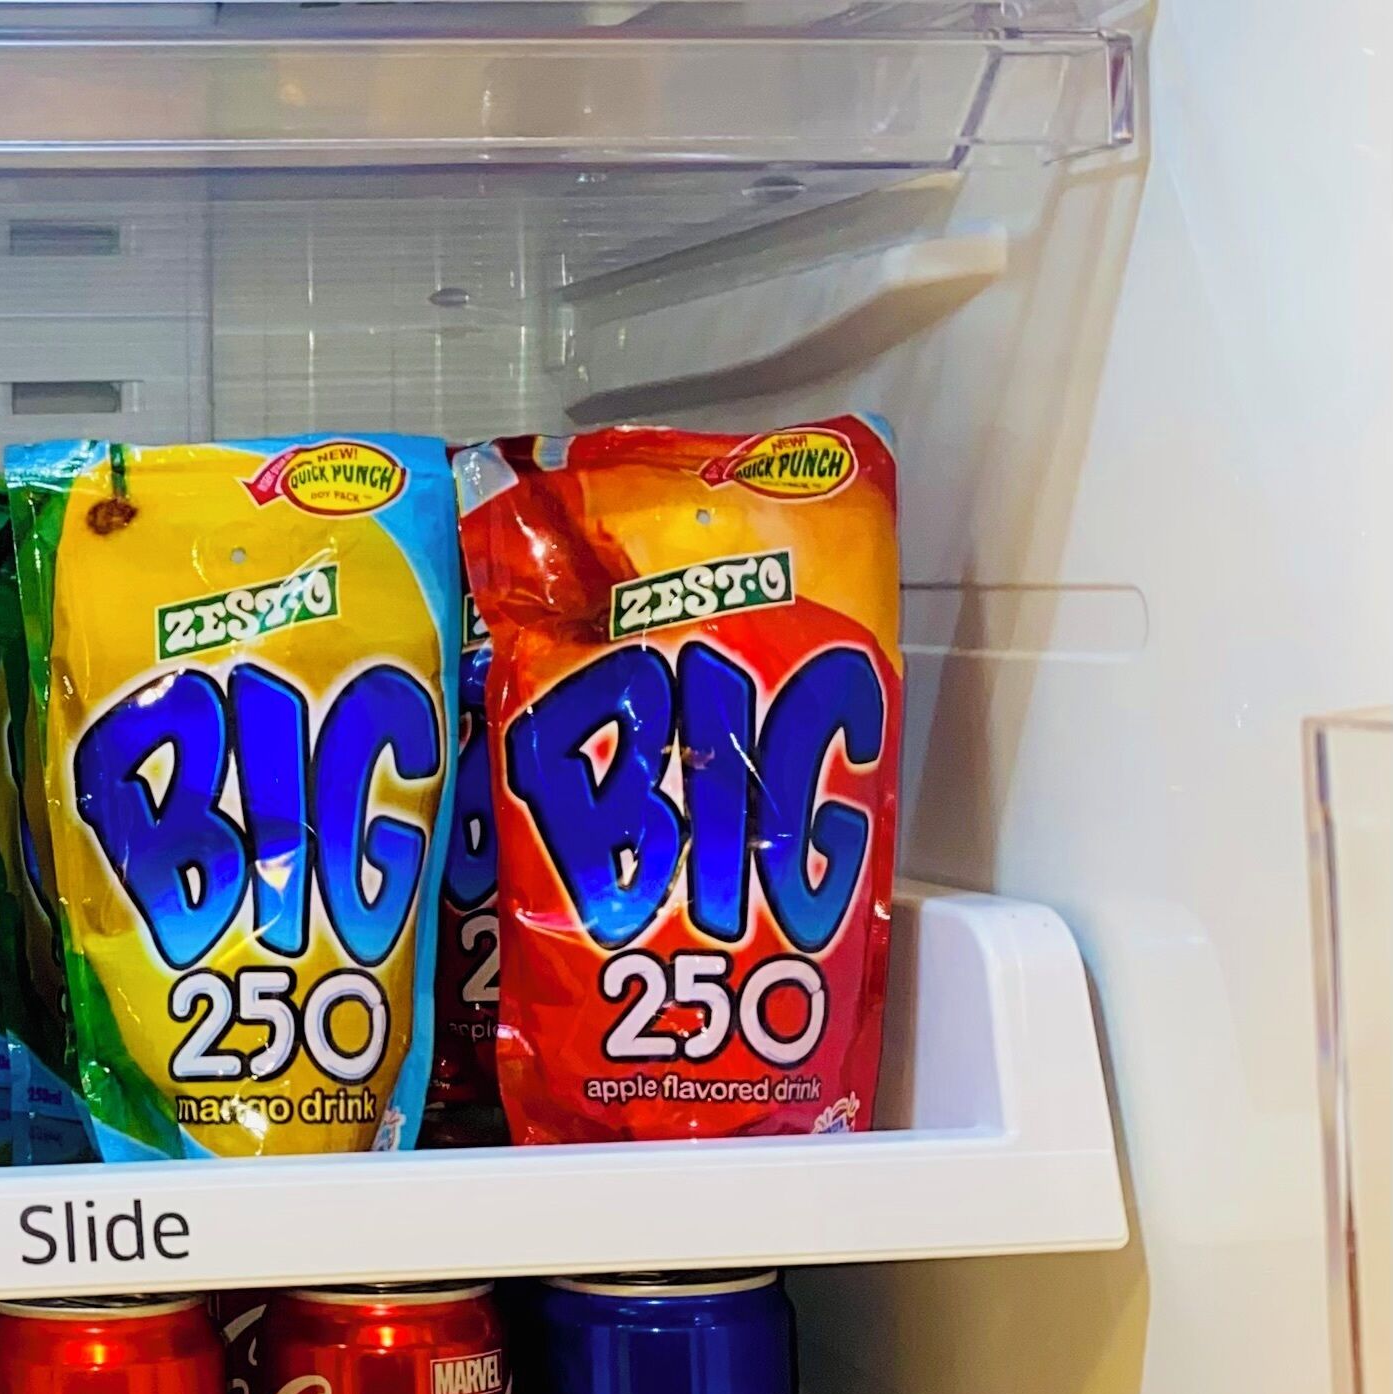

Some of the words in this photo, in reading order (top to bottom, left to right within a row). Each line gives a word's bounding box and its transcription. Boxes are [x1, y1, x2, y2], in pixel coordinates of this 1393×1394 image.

[291, 465, 328, 489] QUICK
[330, 464, 396, 492] PUNCH
[317, 448, 358, 462] NEW!
[778, 448, 844, 477] PUNCH
[73, 661, 442, 969] BIG
[505, 639, 885, 953] BIG
[169, 966, 391, 1083] 250
[601, 949, 830, 1067] 250
[297, 1087, 377, 1124] drink
[586, 1077, 657, 1105] apple
[662, 1075, 769, 1102] flavored
[773, 1077, 822, 1101] drink
[19, 1199, 190, 1265] Slide
